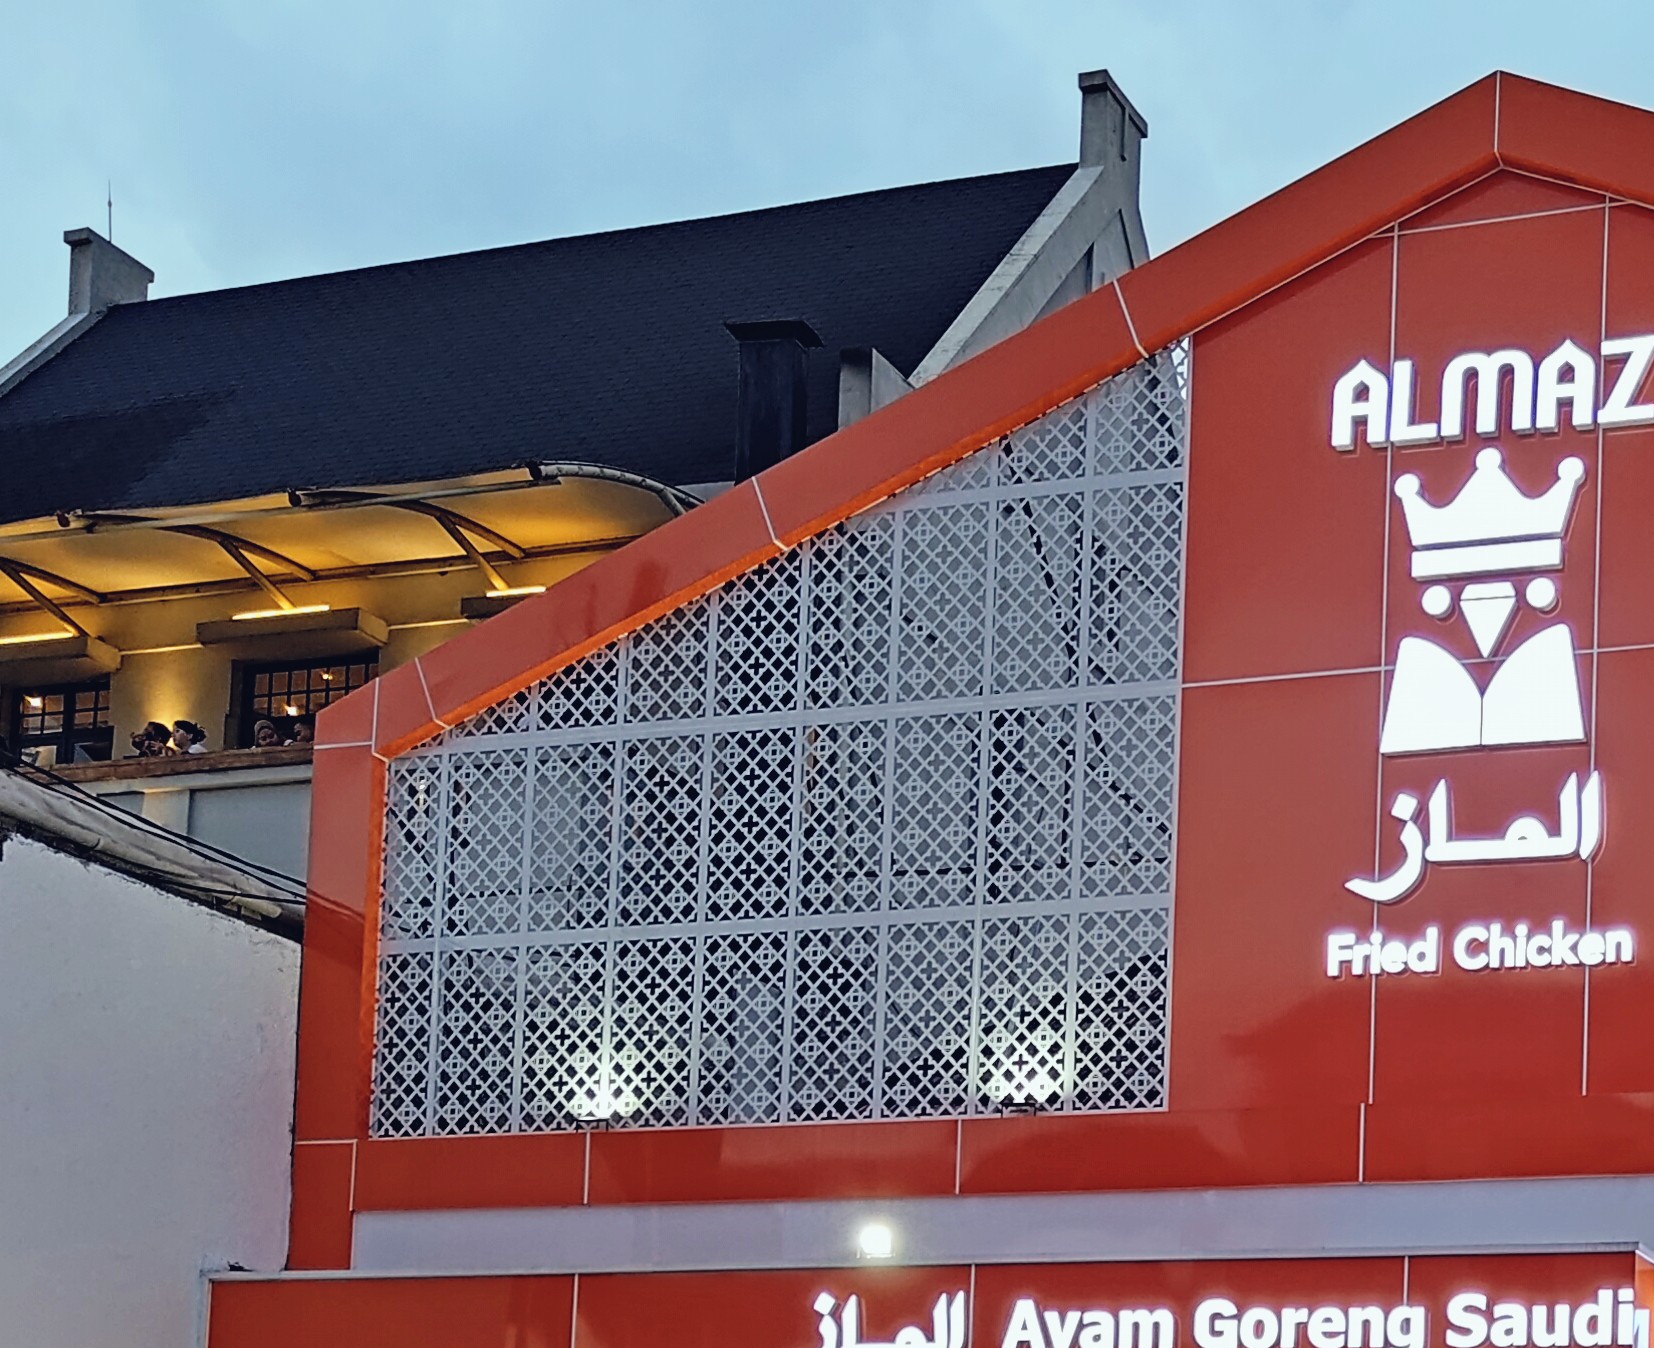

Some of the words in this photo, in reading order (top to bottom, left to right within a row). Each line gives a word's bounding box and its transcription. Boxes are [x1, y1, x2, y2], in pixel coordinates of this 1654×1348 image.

[1345, 771, 1602, 903] الماز
[1327, 926, 1440, 977] Fried
[1453, 920, 1635, 972] Chicken
[1446, 1287, 1634, 1348] Saudi
